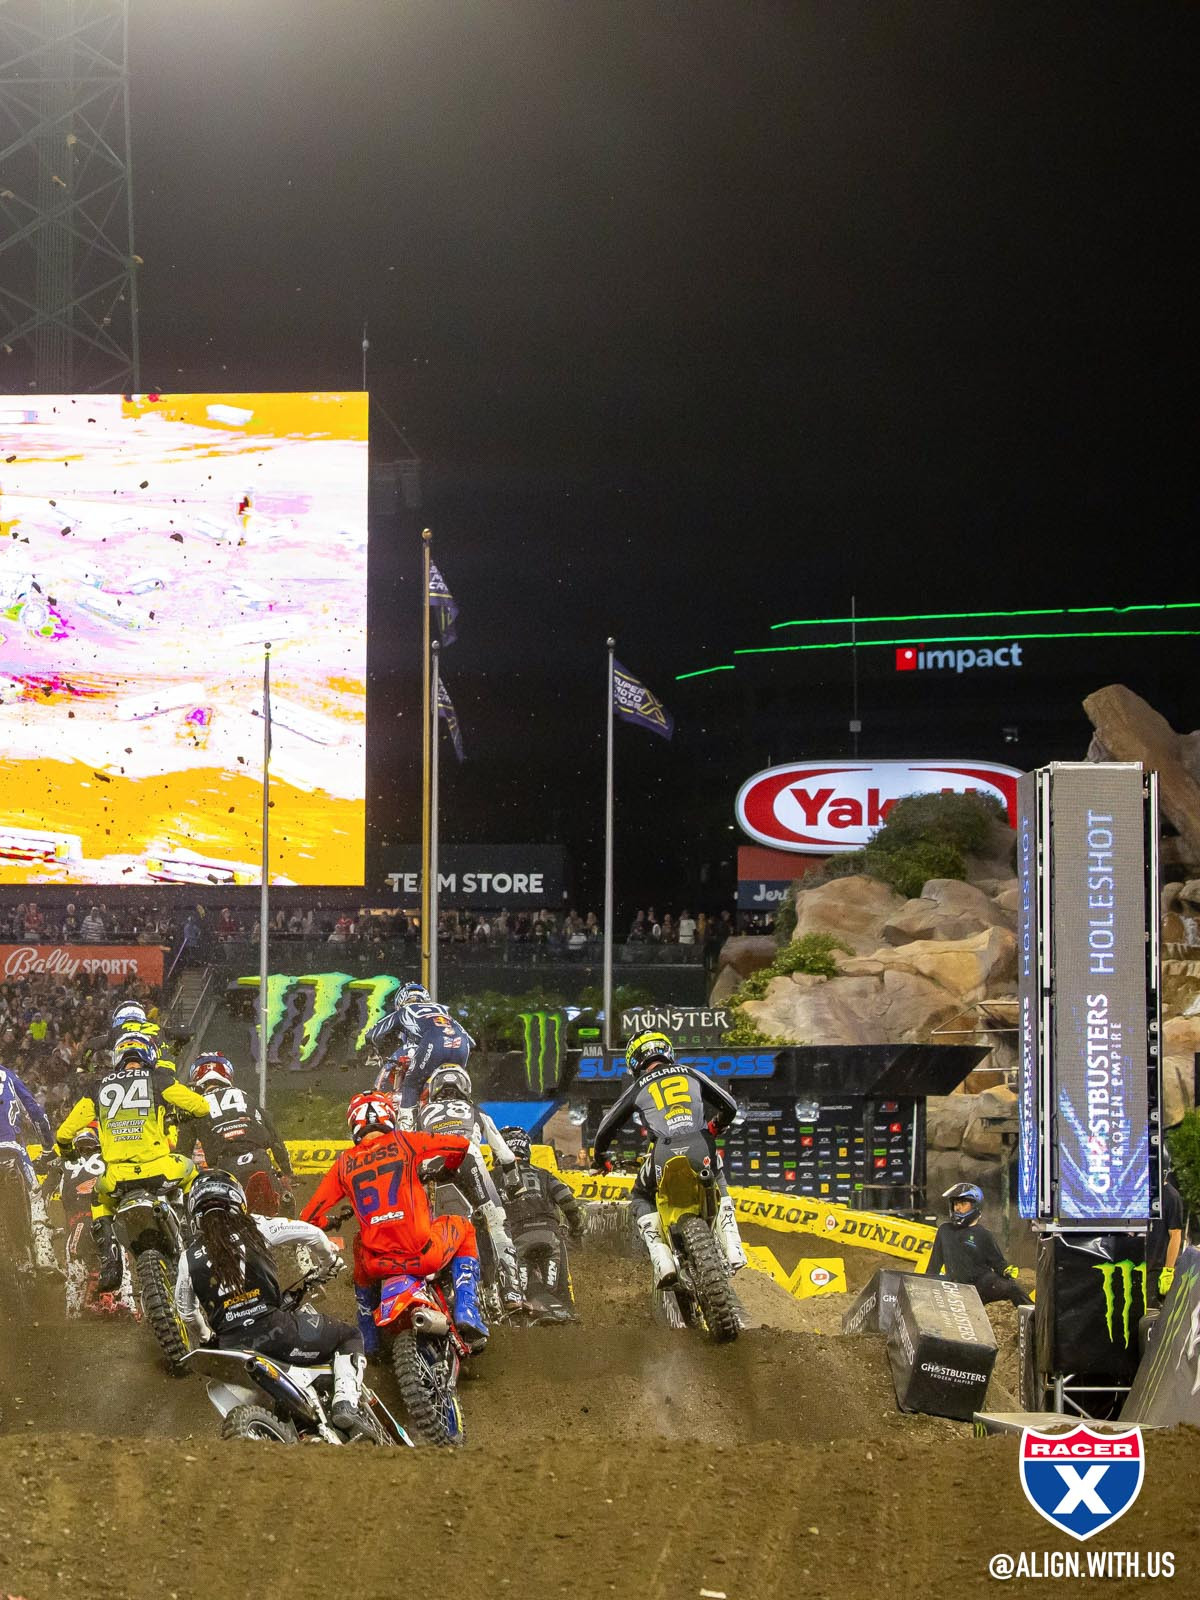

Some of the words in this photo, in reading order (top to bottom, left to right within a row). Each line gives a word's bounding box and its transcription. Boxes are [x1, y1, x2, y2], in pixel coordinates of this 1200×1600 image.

[918, 643, 1023, 673] impact
[790, 788, 977, 829] Yak
[388, 873, 456, 893] TEM
[463, 873, 544, 894] STORE
[1088, 808, 1115, 975] HOLESHOT
[4, 946, 81, 978] Bally
[82, 957, 139, 976] SPORTS
[622, 1009, 730, 1033] MONSTER
[582, 1046, 603, 1057] AMA
[101, 1069, 150, 1084] ROCZEN
[579, 1054, 777, 1079] SUPROSS
[639, 1065, 689, 1087] MCELRATH
[99, 1078, 151, 1120] 94
[203, 1088, 248, 1119] 14
[647, 1075, 692, 1111] 12
[420, 1100, 472, 1128] 28
[112, 1127, 143, 1135] SUZUKI
[223, 1123, 248, 1132] HONDA
[224, 1129, 245, 1138] MOTUL
[346, 1142, 399, 1174] BLOSS
[351, 1159, 404, 1217] 67
[579, 1182, 632, 1200] DUN
[370, 1210, 405, 1225] Beta
[731, 1198, 819, 1227] DUNLOP
[840, 1219, 933, 1255] DUNLOP
[233, 1303, 268, 1320] Husqvarna
[930, 1373, 952, 1382] FROZEN
[953, 1378, 974, 1386] EMPIRE
